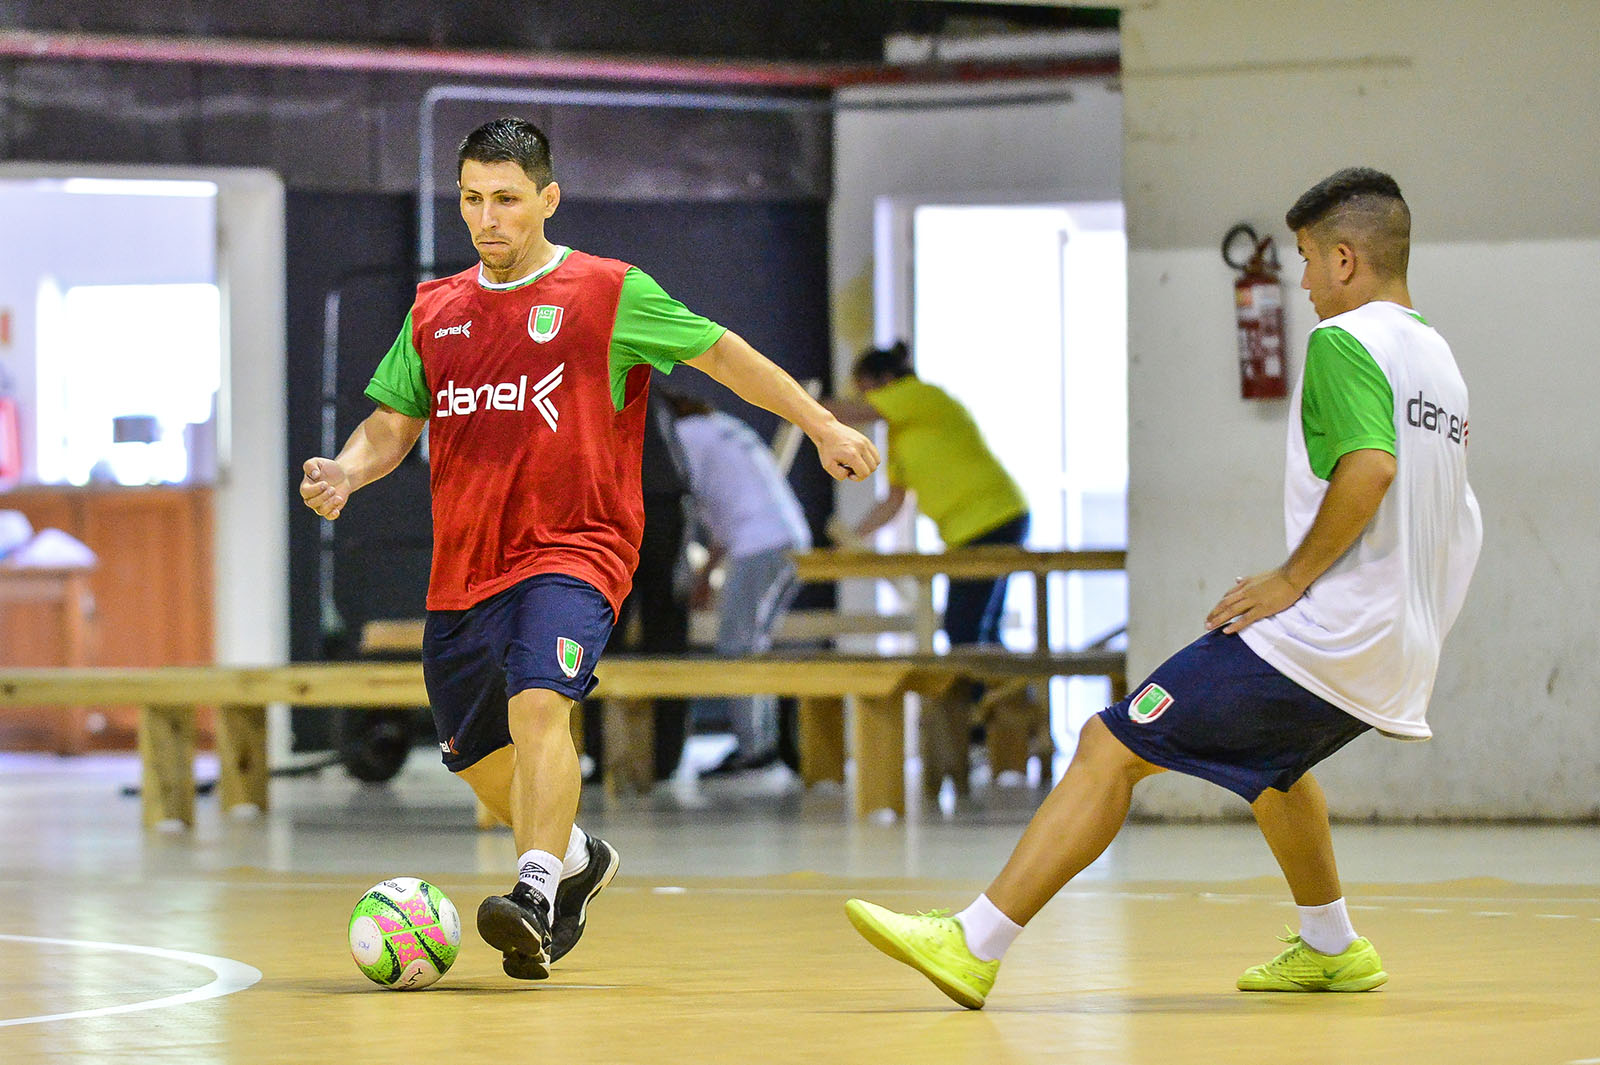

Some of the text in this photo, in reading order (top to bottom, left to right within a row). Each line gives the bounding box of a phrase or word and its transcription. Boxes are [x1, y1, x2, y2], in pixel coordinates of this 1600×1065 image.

[434, 324, 462, 339] danel
[436, 374, 528, 418] danel
[1406, 390, 1464, 444] danel
